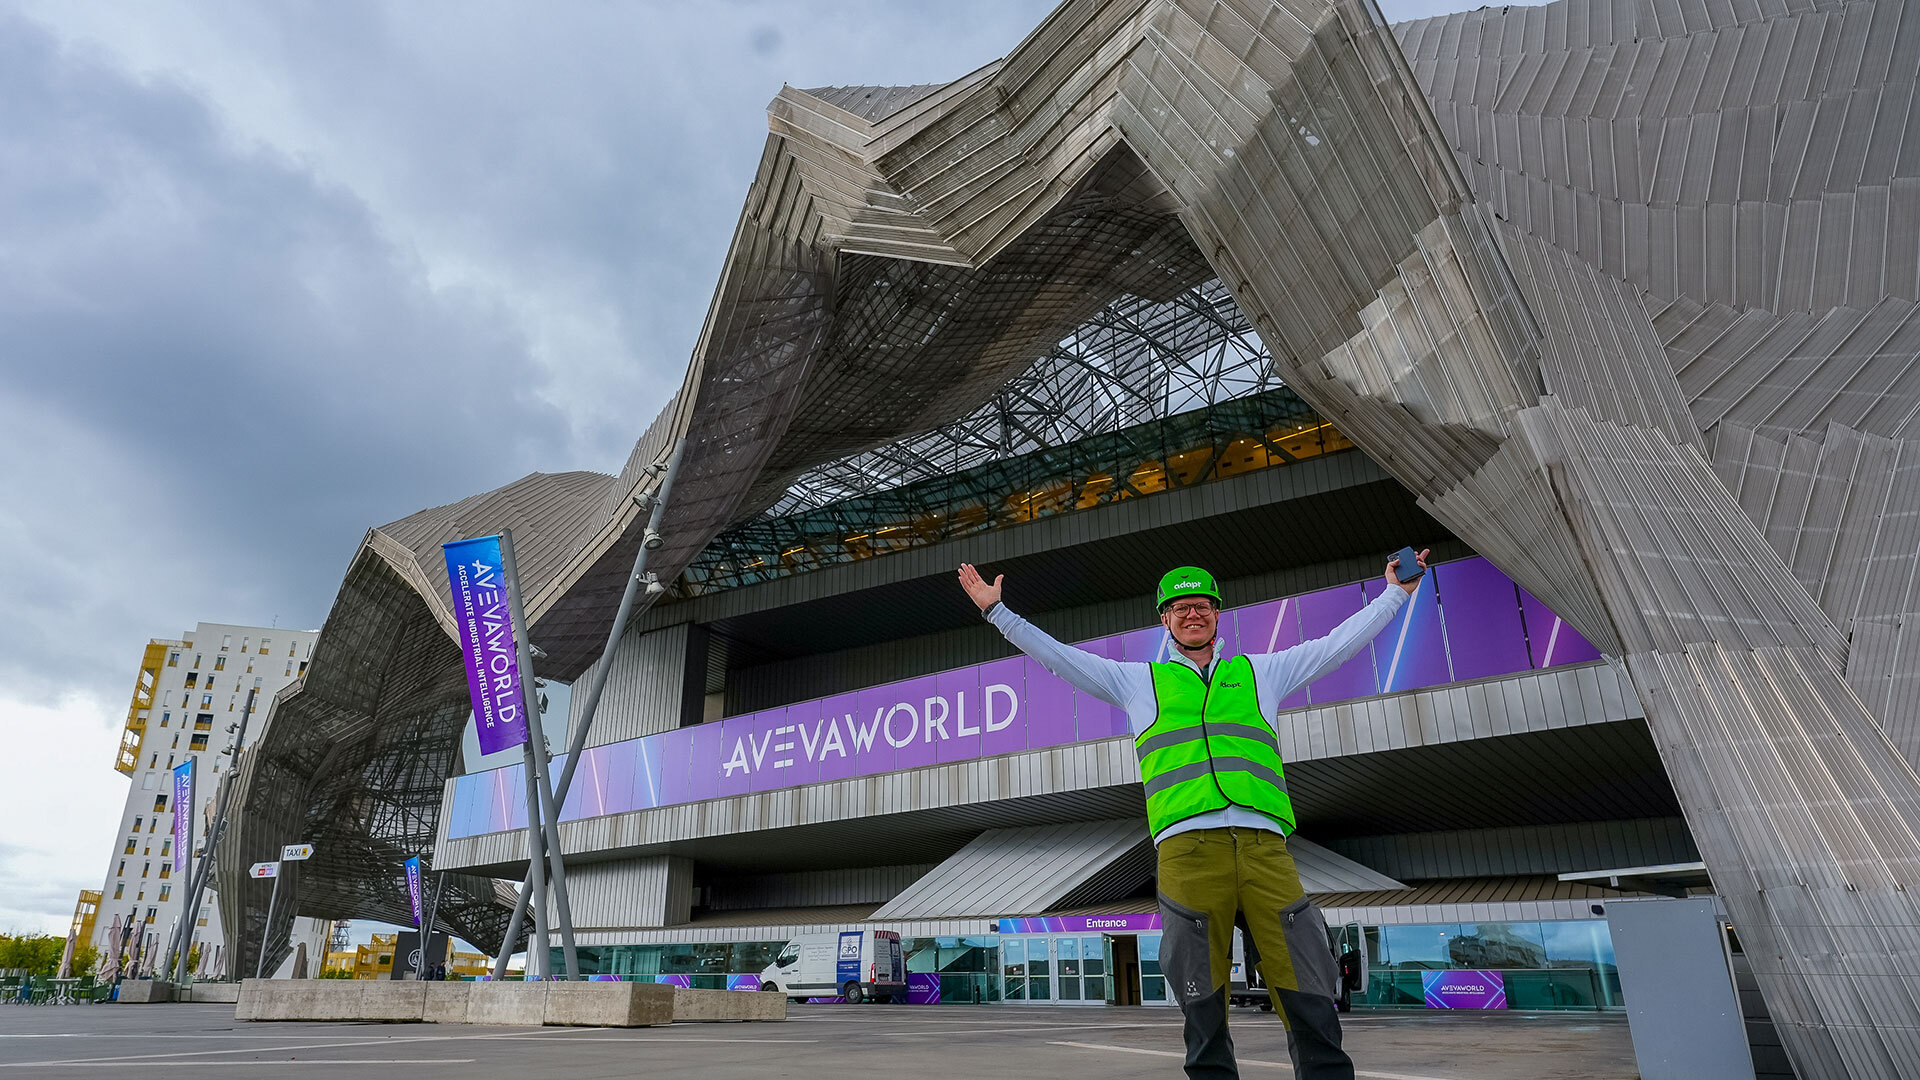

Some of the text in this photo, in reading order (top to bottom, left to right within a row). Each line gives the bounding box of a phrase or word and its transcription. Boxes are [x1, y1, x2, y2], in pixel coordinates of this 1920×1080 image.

[1173, 580, 1202, 590] adapt
[457, 564, 495, 729] ACCELERATE INDUSTRIAL INTELLIGENCE
[471, 559, 517, 724] AVEVAWORLD
[722, 683, 1019, 778] AVEVAWORLD
[181, 773, 191, 857] AVEVAWORLD
[286, 848, 302, 857] TAXI
[411, 865, 419, 917] AVEVAWORLD
[1086, 918, 1127, 928] Entrance
[841, 945, 858, 955] GPO
